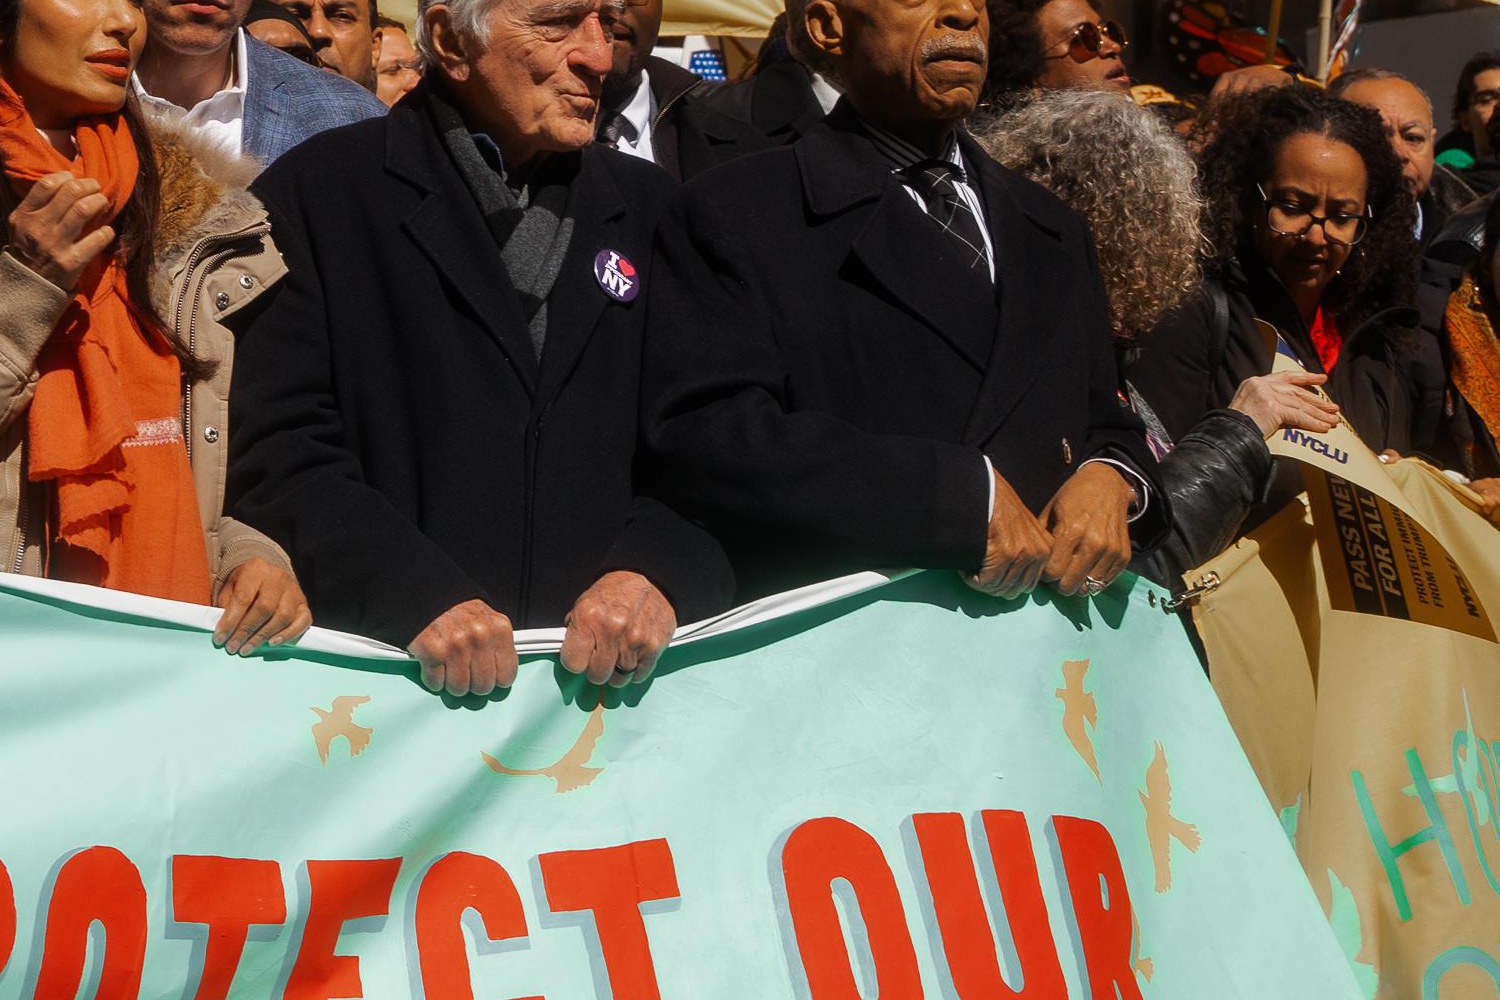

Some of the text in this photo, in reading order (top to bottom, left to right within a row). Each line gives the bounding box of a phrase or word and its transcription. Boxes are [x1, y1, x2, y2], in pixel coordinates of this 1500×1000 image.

[601, 267, 632, 297] NY
[1283, 424, 1349, 465] NYCLU
[1338, 526, 1374, 592] PASS
[1364, 495, 1402, 597] FOR ALL
[1402, 547, 1430, 605] PROTECT
[1427, 574, 1445, 609] FROM
[767, 808, 1145, 1000] OUR
